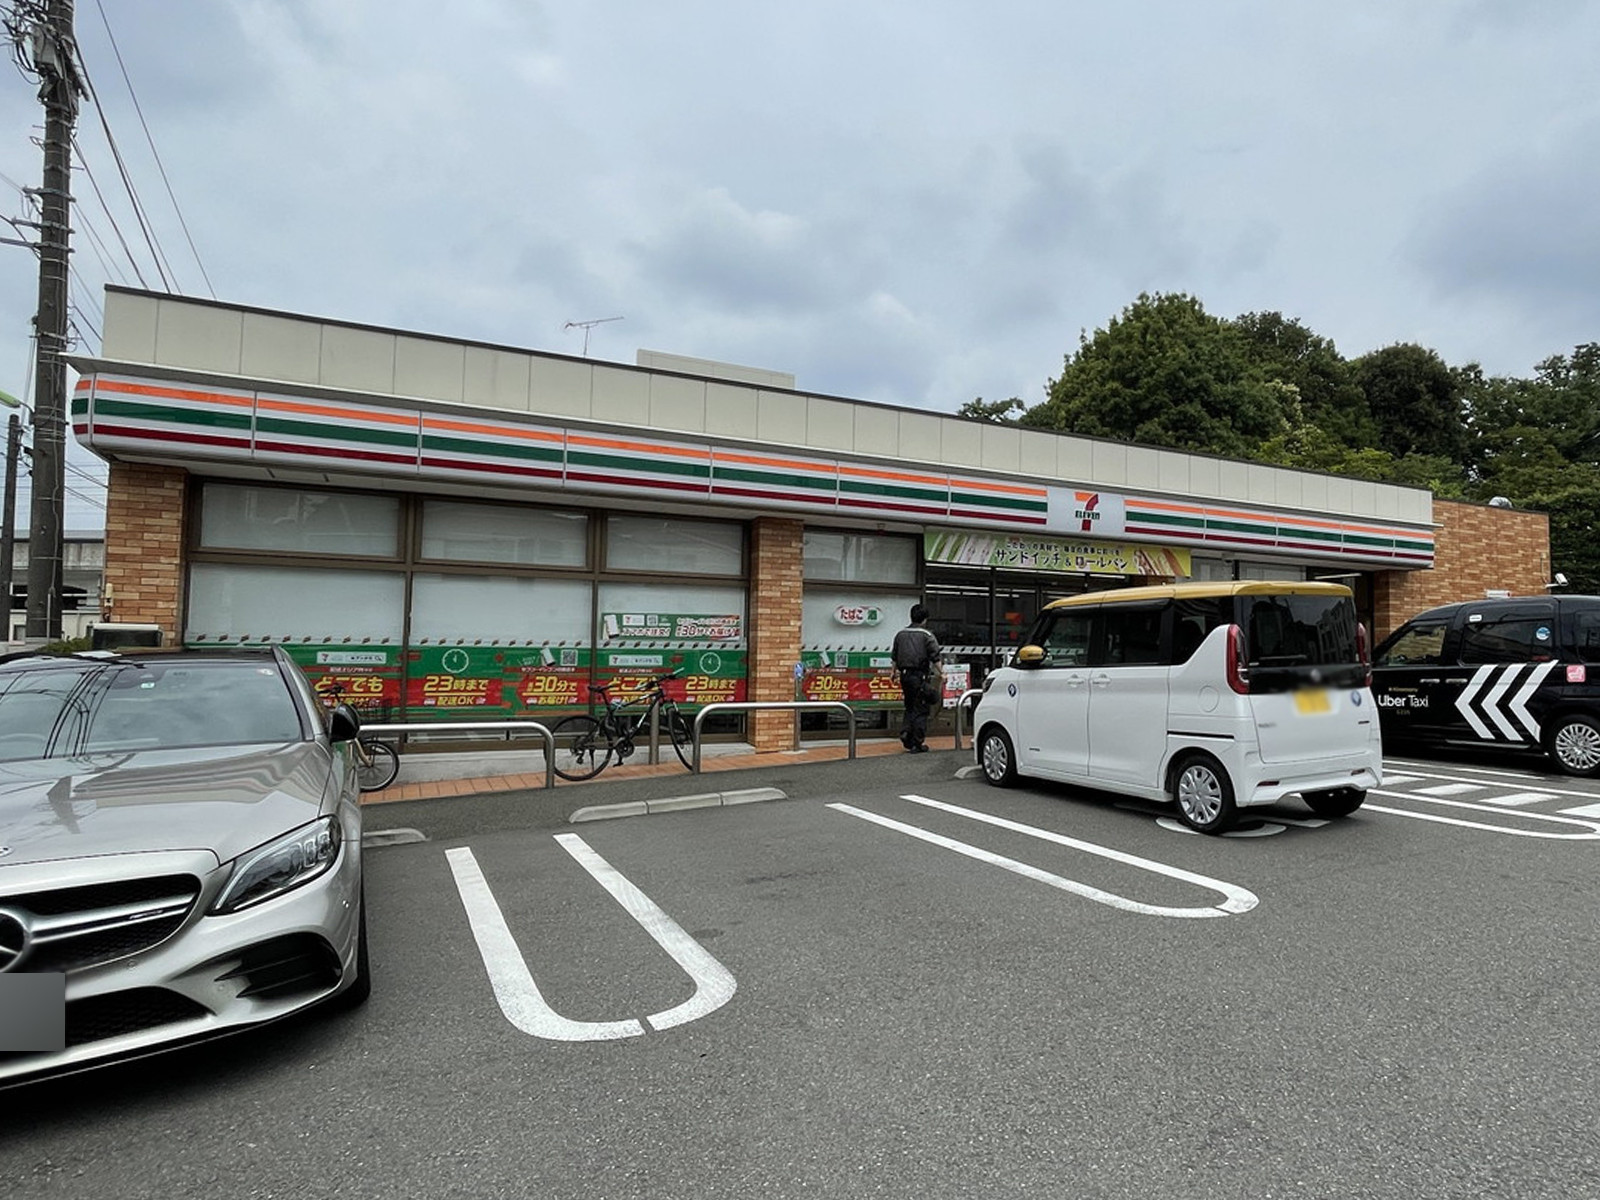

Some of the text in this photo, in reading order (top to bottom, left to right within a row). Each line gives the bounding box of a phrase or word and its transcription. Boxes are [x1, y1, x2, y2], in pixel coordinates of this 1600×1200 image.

[996, 549, 1060, 566] サンドイッチ
[1075, 556, 1128, 570] ロールパン
[840, 609, 863, 620] たばこ
[423, 675, 489, 691] 23時まで
[1378, 694, 1429, 708] Uber Taxi
